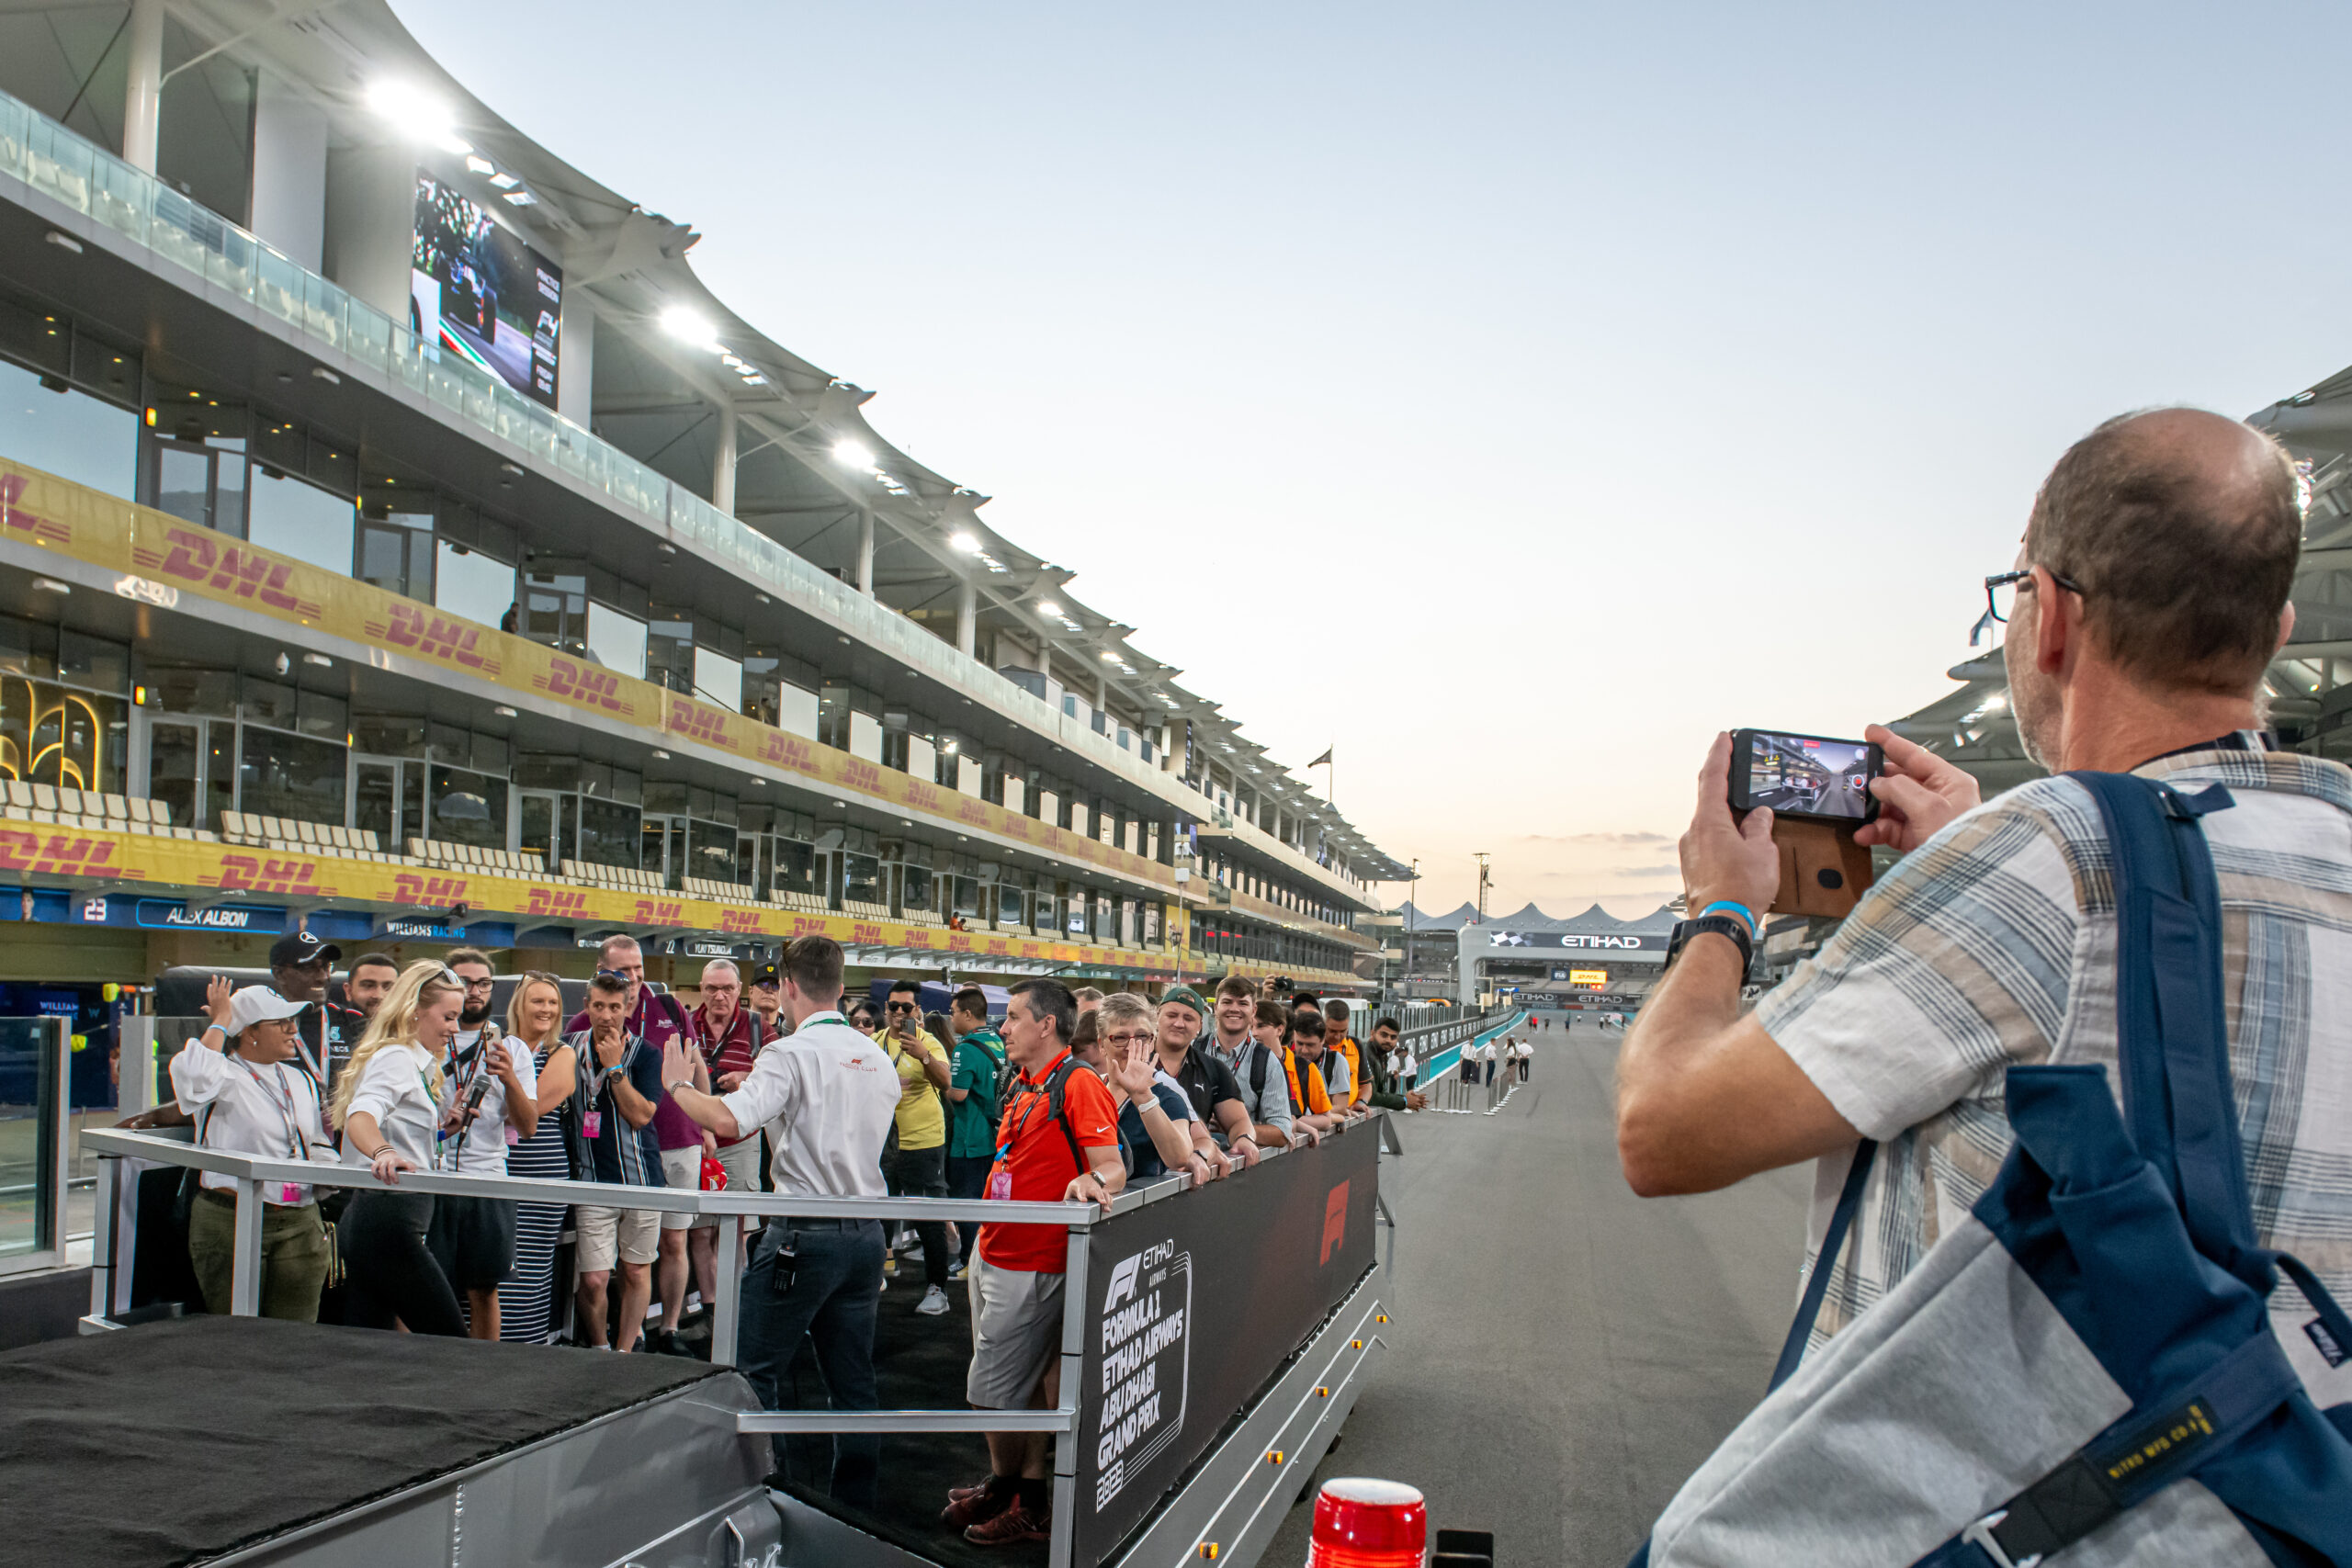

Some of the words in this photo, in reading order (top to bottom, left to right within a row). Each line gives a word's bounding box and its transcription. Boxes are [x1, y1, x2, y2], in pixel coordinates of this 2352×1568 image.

[162, 527, 297, 611] DHL
[385, 604, 485, 669] DHL
[548, 659, 621, 712] DHL
[670, 700, 729, 747] DHL
[766, 733, 812, 772] DHL
[843, 759, 881, 794] DHL
[907, 781, 938, 809] DHL
[0, 830, 123, 878] DHL
[219, 854, 321, 896] DHL
[392, 874, 471, 908] DHL
[527, 887, 589, 919] DHL
[85, 898, 107, 921] 23
[203, 909, 249, 927] ALBON
[635, 900, 684, 927] DHL
[721, 909, 763, 934] DHL
[387, 921, 432, 937] WILLIAMS
[433, 924, 466, 939] RACNG
[854, 924, 883, 945] DHL
[904, 930, 931, 949] DHL
[949, 935, 972, 953] DHL
[1562, 934, 1642, 949] ETIHAD
[666, 940, 675, 954] 22
[1554, 971, 1566, 979] FIA
[1512, 992, 1555, 1001] ETIHAD
[1578, 995, 1623, 1004] ETIHAD
[1143, 1238, 1174, 1269] ETIHAD
[1149, 1267, 1167, 1288] AIRWAYS
[1102, 1293, 1154, 1355] FORMULA
[1154, 1289, 1161, 1320] 1
[1102, 1337, 1143, 1394] ETIHAD
[1143, 1308, 1183, 1363] AIRWAYS
[1099, 1383, 1125, 1434] ABU
[1125, 1360, 1156, 1413] DHABI
[1097, 1412, 1137, 1472] GRAND
[1137, 1390, 1161, 1438] PRIX
